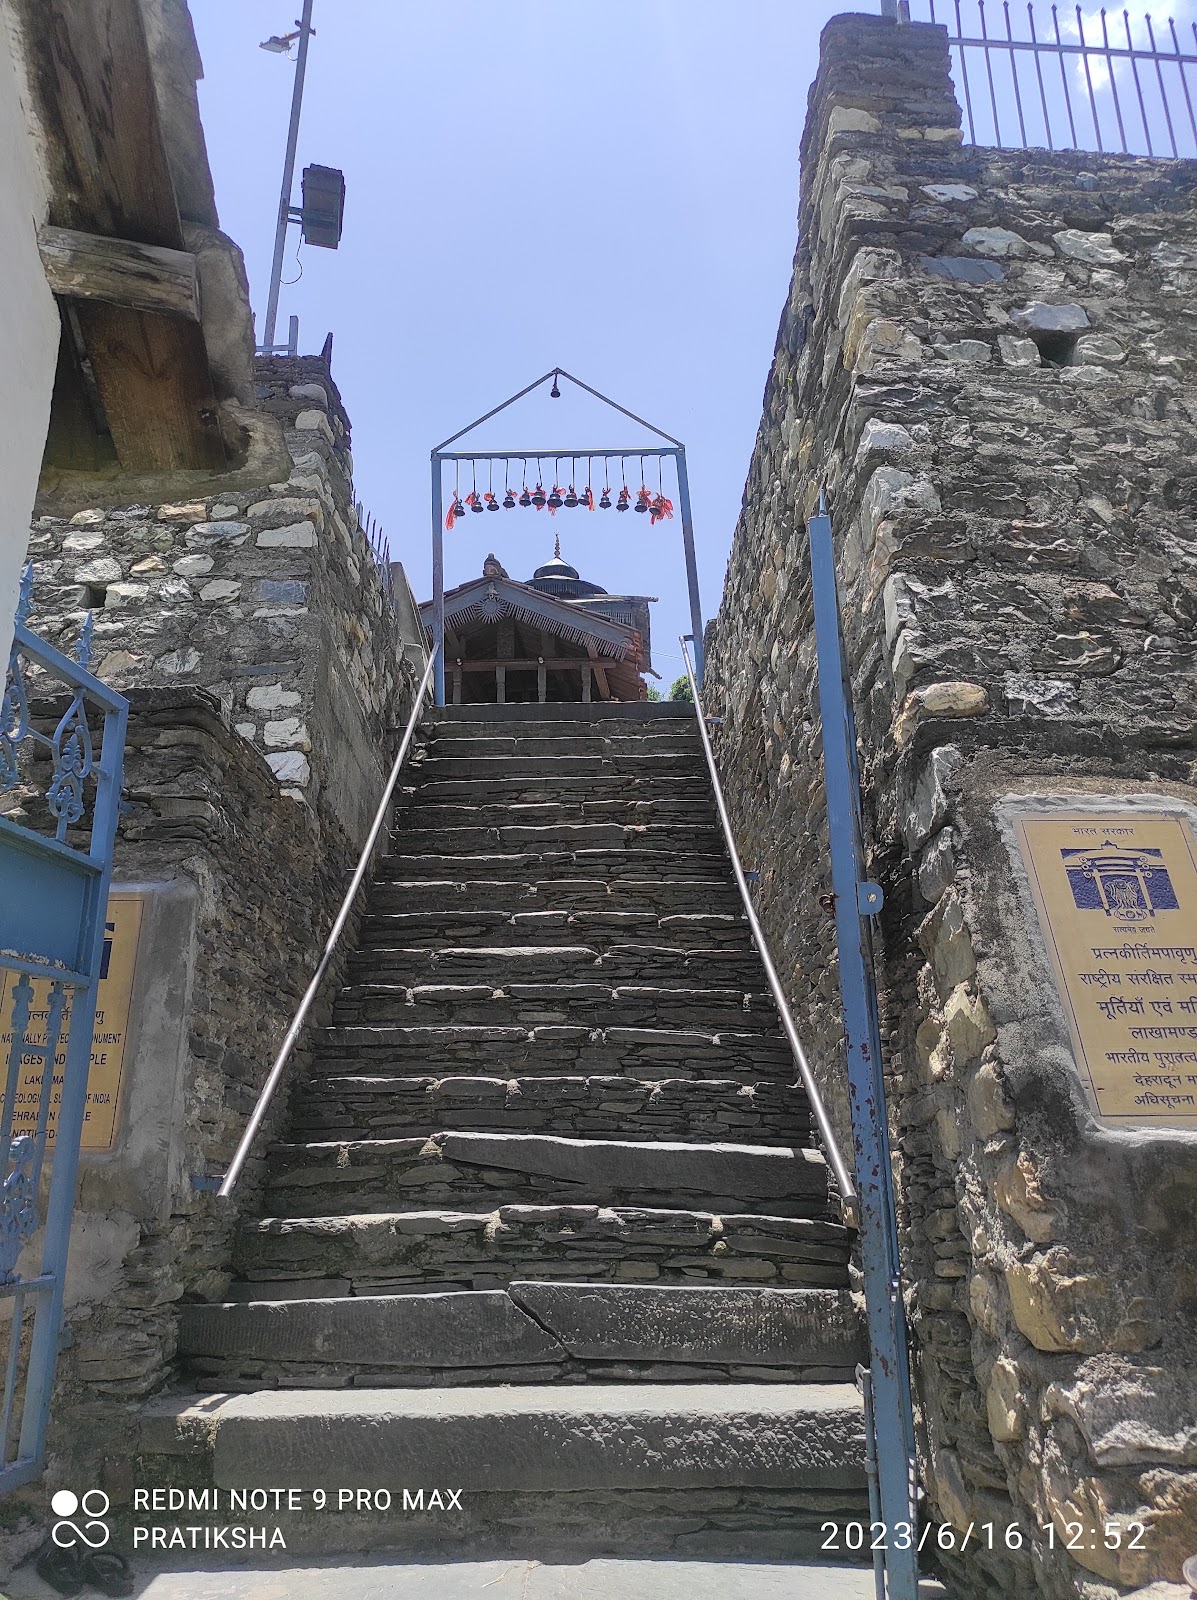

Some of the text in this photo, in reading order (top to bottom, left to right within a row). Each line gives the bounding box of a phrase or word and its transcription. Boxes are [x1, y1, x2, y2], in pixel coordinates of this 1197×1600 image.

[1072, 827, 1135, 836] भारत सरकार
[1078, 969, 1122, 987] राष्ट्रीय
[1125, 969, 1174, 986] संरक्षित
[1149, 997, 1173, 1017] एवं
[93, 1033, 122, 1043] NUMENT
[1128, 1026, 1197, 1039] लाखामण्ड
[54, 1053, 66, 1064] ND
[1105, 1047, 1150, 1064] भारतीय
[1133, 1072, 1182, 1089] देहरादून
[93, 1093, 111, 1104] INDIA
[1134, 1091, 1195, 1109] अधिसूचना
